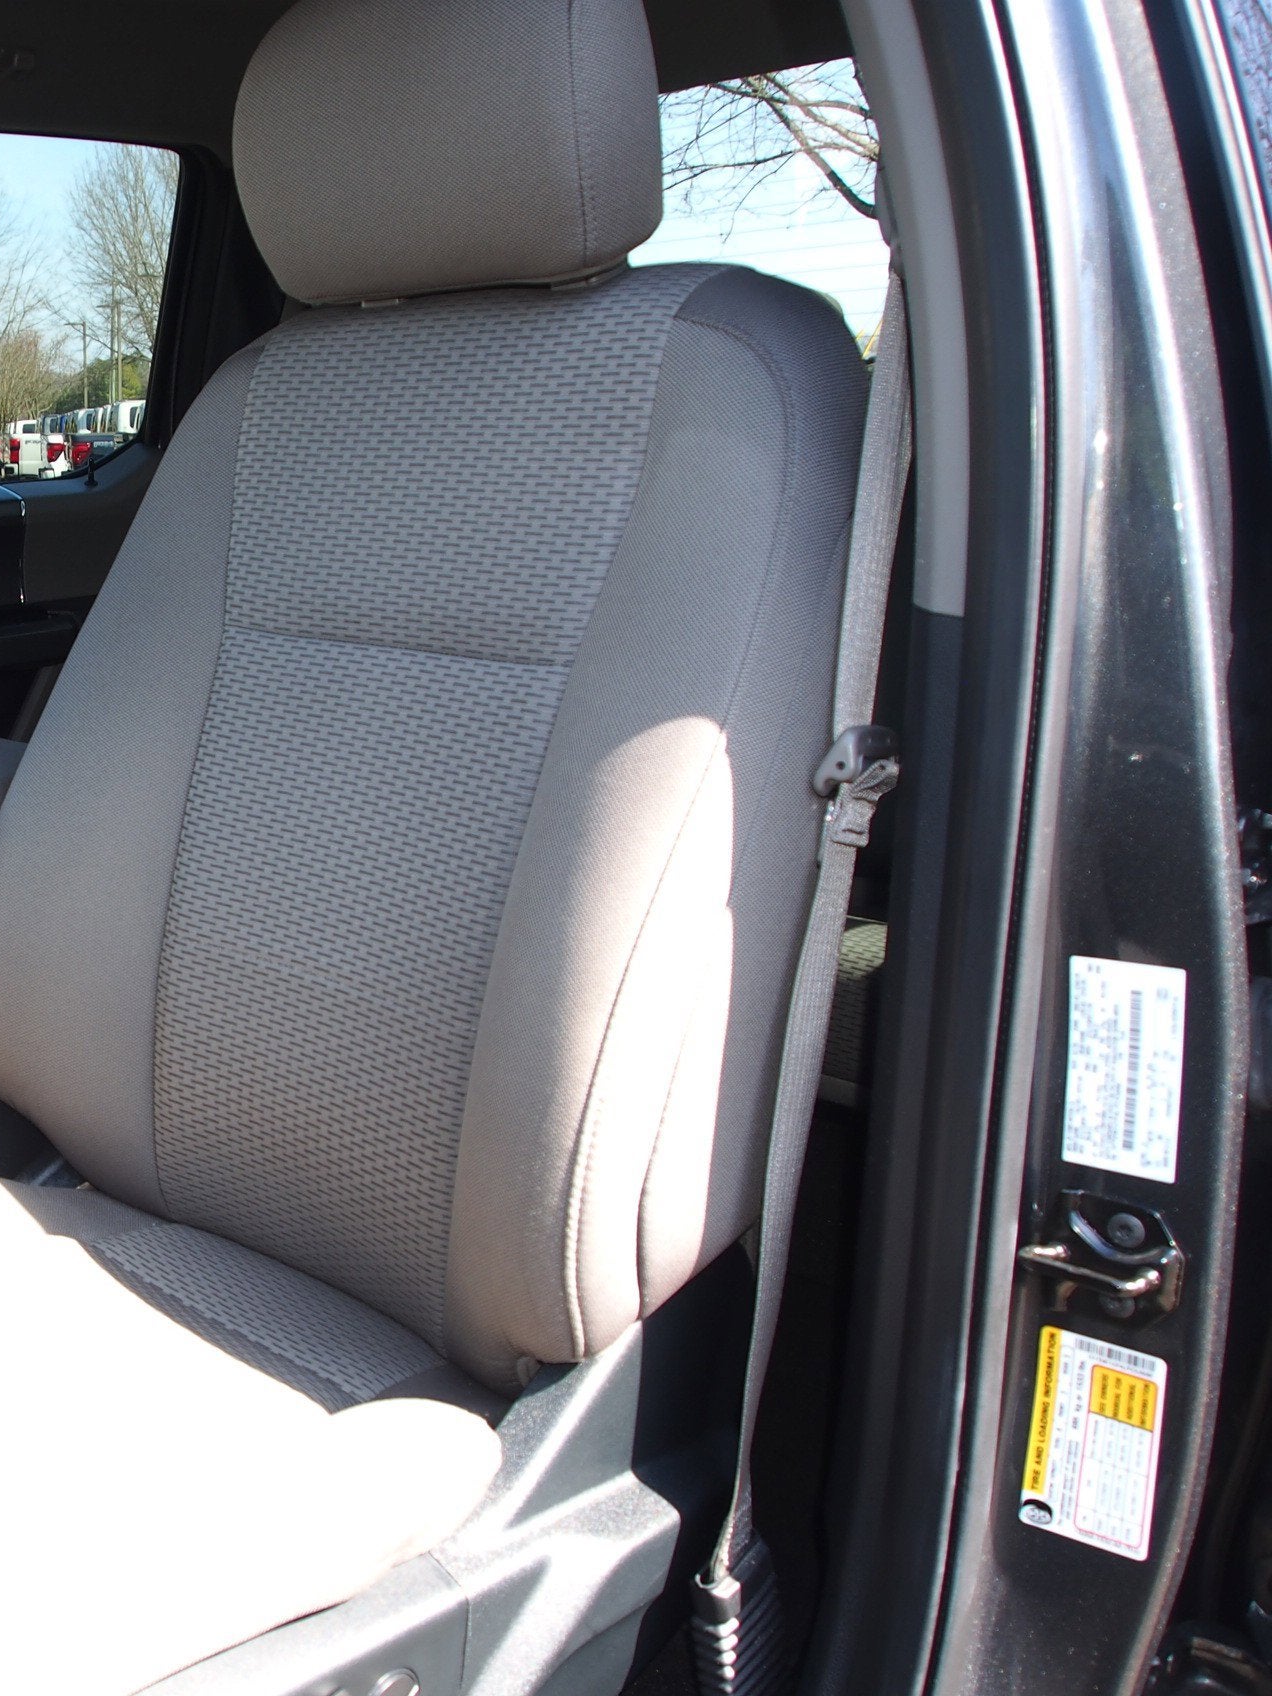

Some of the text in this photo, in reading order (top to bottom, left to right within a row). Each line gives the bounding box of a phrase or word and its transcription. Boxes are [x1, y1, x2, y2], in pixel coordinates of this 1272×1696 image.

[1030, 1331, 1056, 1491] TIRE AND LOADING INFORMATION
